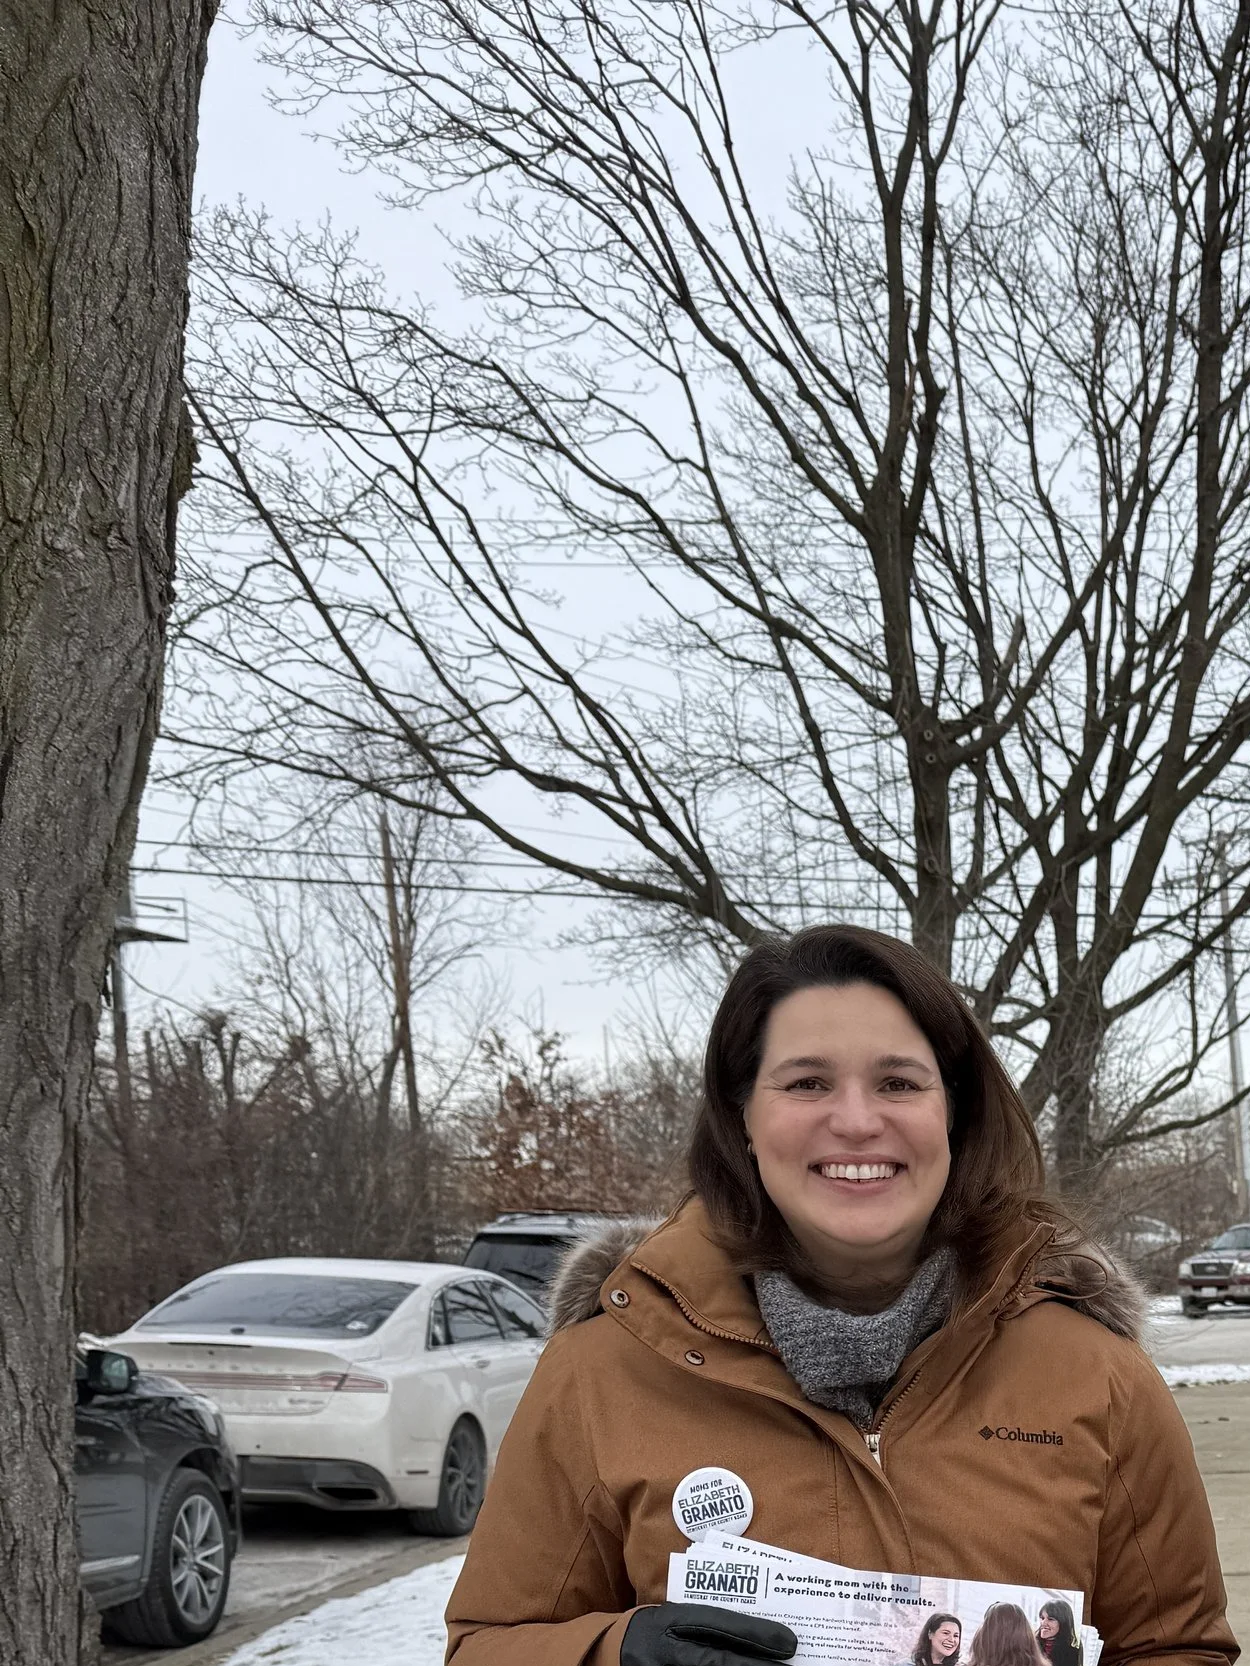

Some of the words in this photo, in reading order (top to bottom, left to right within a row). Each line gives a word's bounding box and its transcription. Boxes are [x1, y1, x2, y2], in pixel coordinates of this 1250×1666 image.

[995, 1426, 1064, 1446] Columbia
[678, 1484, 740, 1509] ELIZABETH
[690, 1482, 709, 1494] MOMS
[710, 1479, 722, 1488] FOR
[681, 1495, 745, 1525] GRANATO
[687, 1559, 759, 1576] ELIZABETH
[685, 1571, 758, 1595] GRANATO
[775, 1572, 784, 1581] A
[786, 1574, 831, 1587] working
[834, 1579, 860, 1588] mom
[862, 1580, 887, 1591] with
[890, 1583, 909, 1593] the
[773, 1586, 836, 1598] experience
[838, 1591, 851, 1599] to
[853, 1592, 892, 1603] deliver
[894, 1597, 936, 1607] results.
